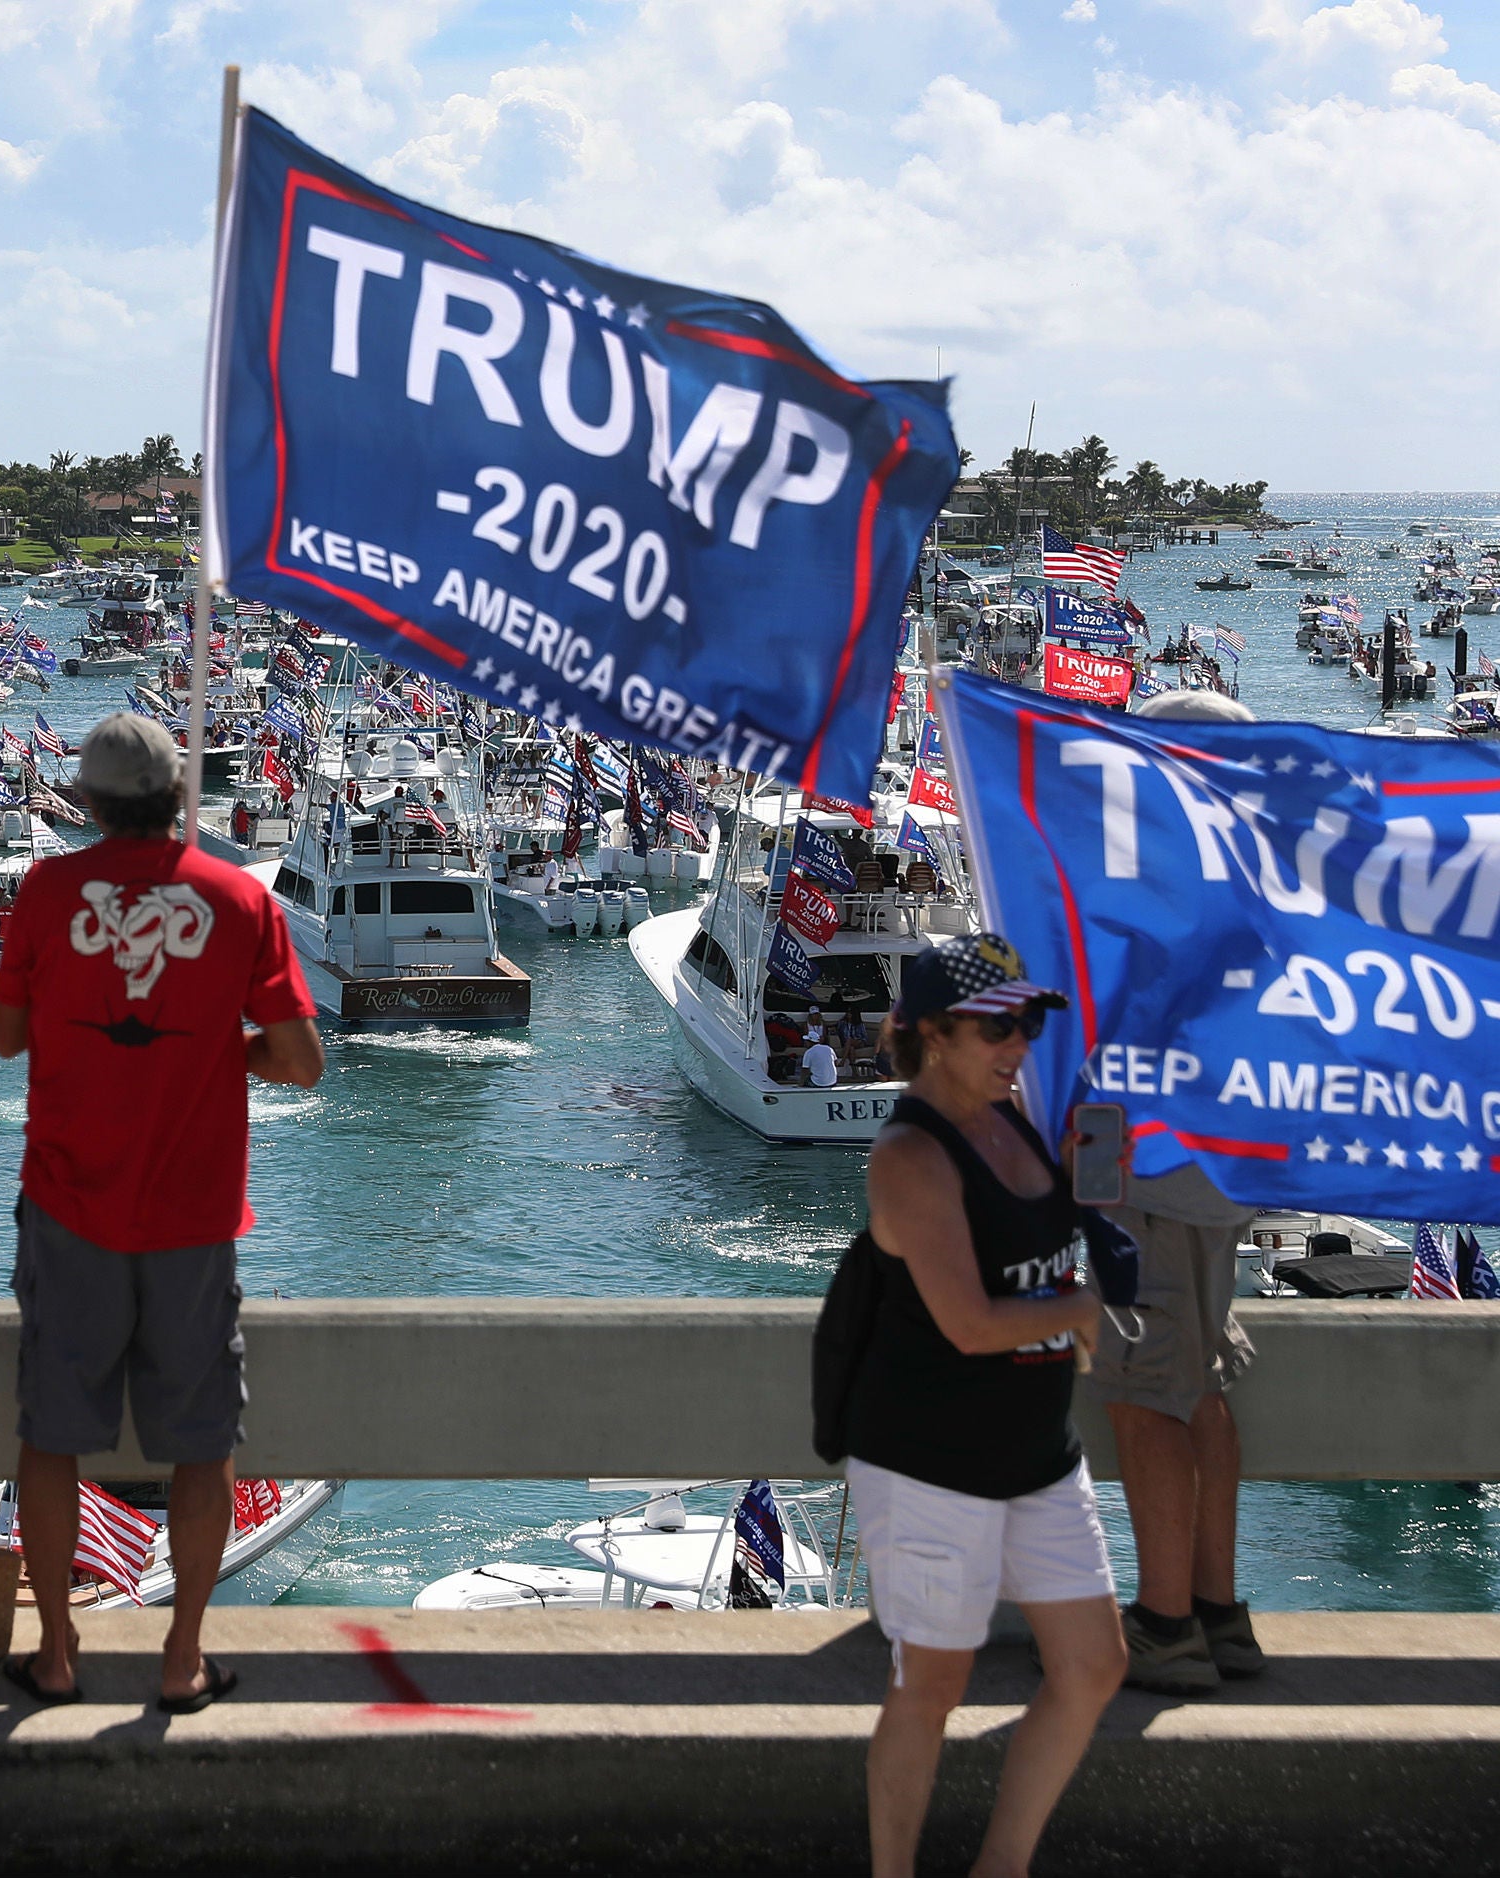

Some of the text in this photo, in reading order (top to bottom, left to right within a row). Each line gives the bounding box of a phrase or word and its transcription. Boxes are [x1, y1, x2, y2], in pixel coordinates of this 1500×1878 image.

[307, 225, 852, 550] TRUMP
[436, 467, 687, 625] -2020-
[289, 517, 420, 590] KEEP
[433, 568, 615, 700] AMERICA
[1072, 613, 1108, 626] -2020-
[1054, 623, 1071, 633] KEEP
[1072, 624, 1100, 635] AMERICA
[1054, 652, 1125, 678] TRUMP
[1052, 681, 1069, 691] KEEP
[1070, 673, 1106, 690] -2020-
[811, 862, 834, 876] AMERICA
[793, 881, 840, 925] TRUMP
[784, 961, 811, 980] -2020-
[360, 986, 402, 1012] Reel
[1217, 1056, 1469, 1130] AMERICA
[745, 1516, 767, 1543] MORE
